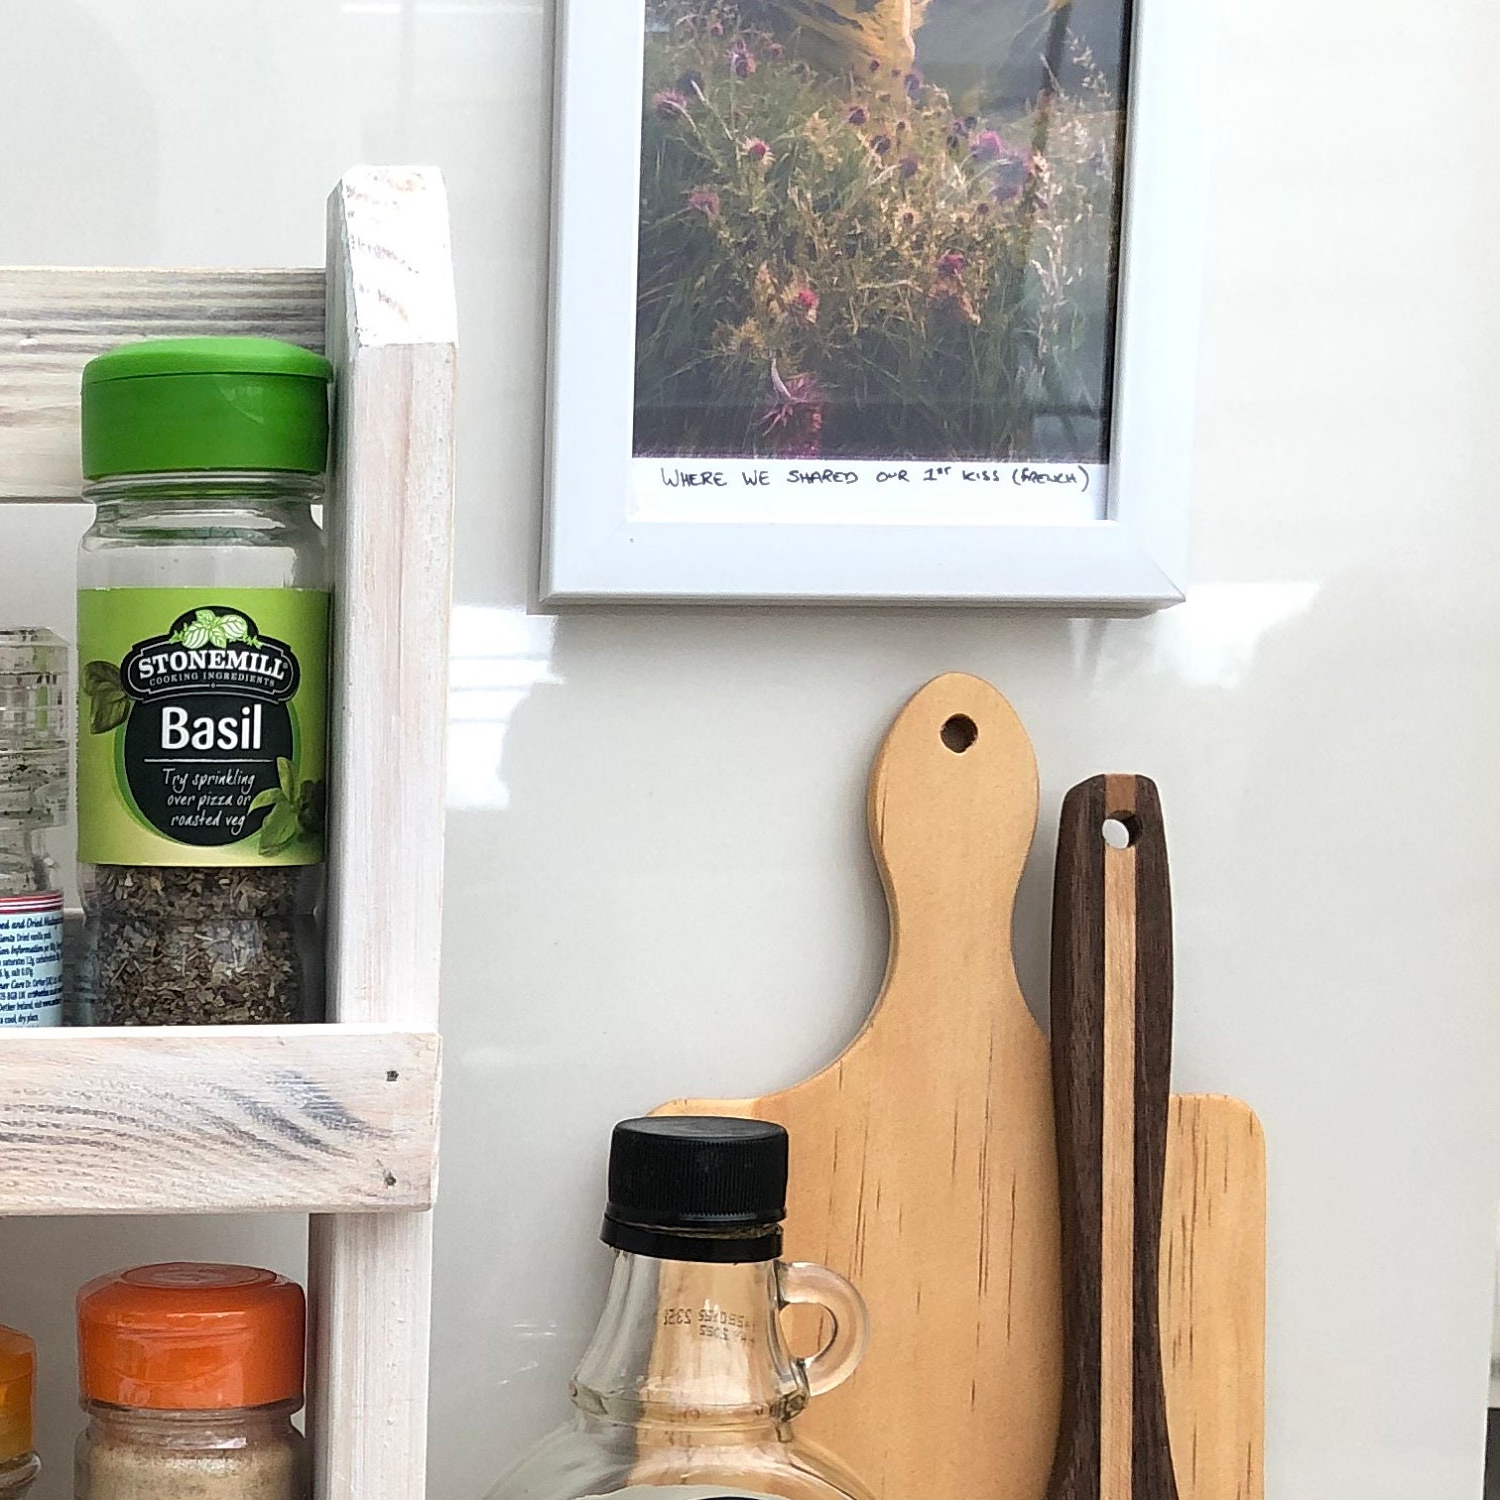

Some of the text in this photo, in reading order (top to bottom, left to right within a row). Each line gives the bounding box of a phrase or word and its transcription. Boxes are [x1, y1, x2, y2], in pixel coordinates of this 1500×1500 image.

[660, 467, 727, 488] WHERE
[741, 469, 771, 487] WE
[786, 468, 859, 485] SHARED
[875, 469, 910, 483] OUR
[137, 650, 285, 681] STONEMILL
[149, 671, 276, 688] COOKING INGREDIENTS
[160, 703, 263, 751] Basil
[162, 767, 256, 795] Try sprinkling
[166, 793, 251, 815] over pizza or
[170, 811, 246, 836] roasted veg
[11, 918, 26, 930] and
